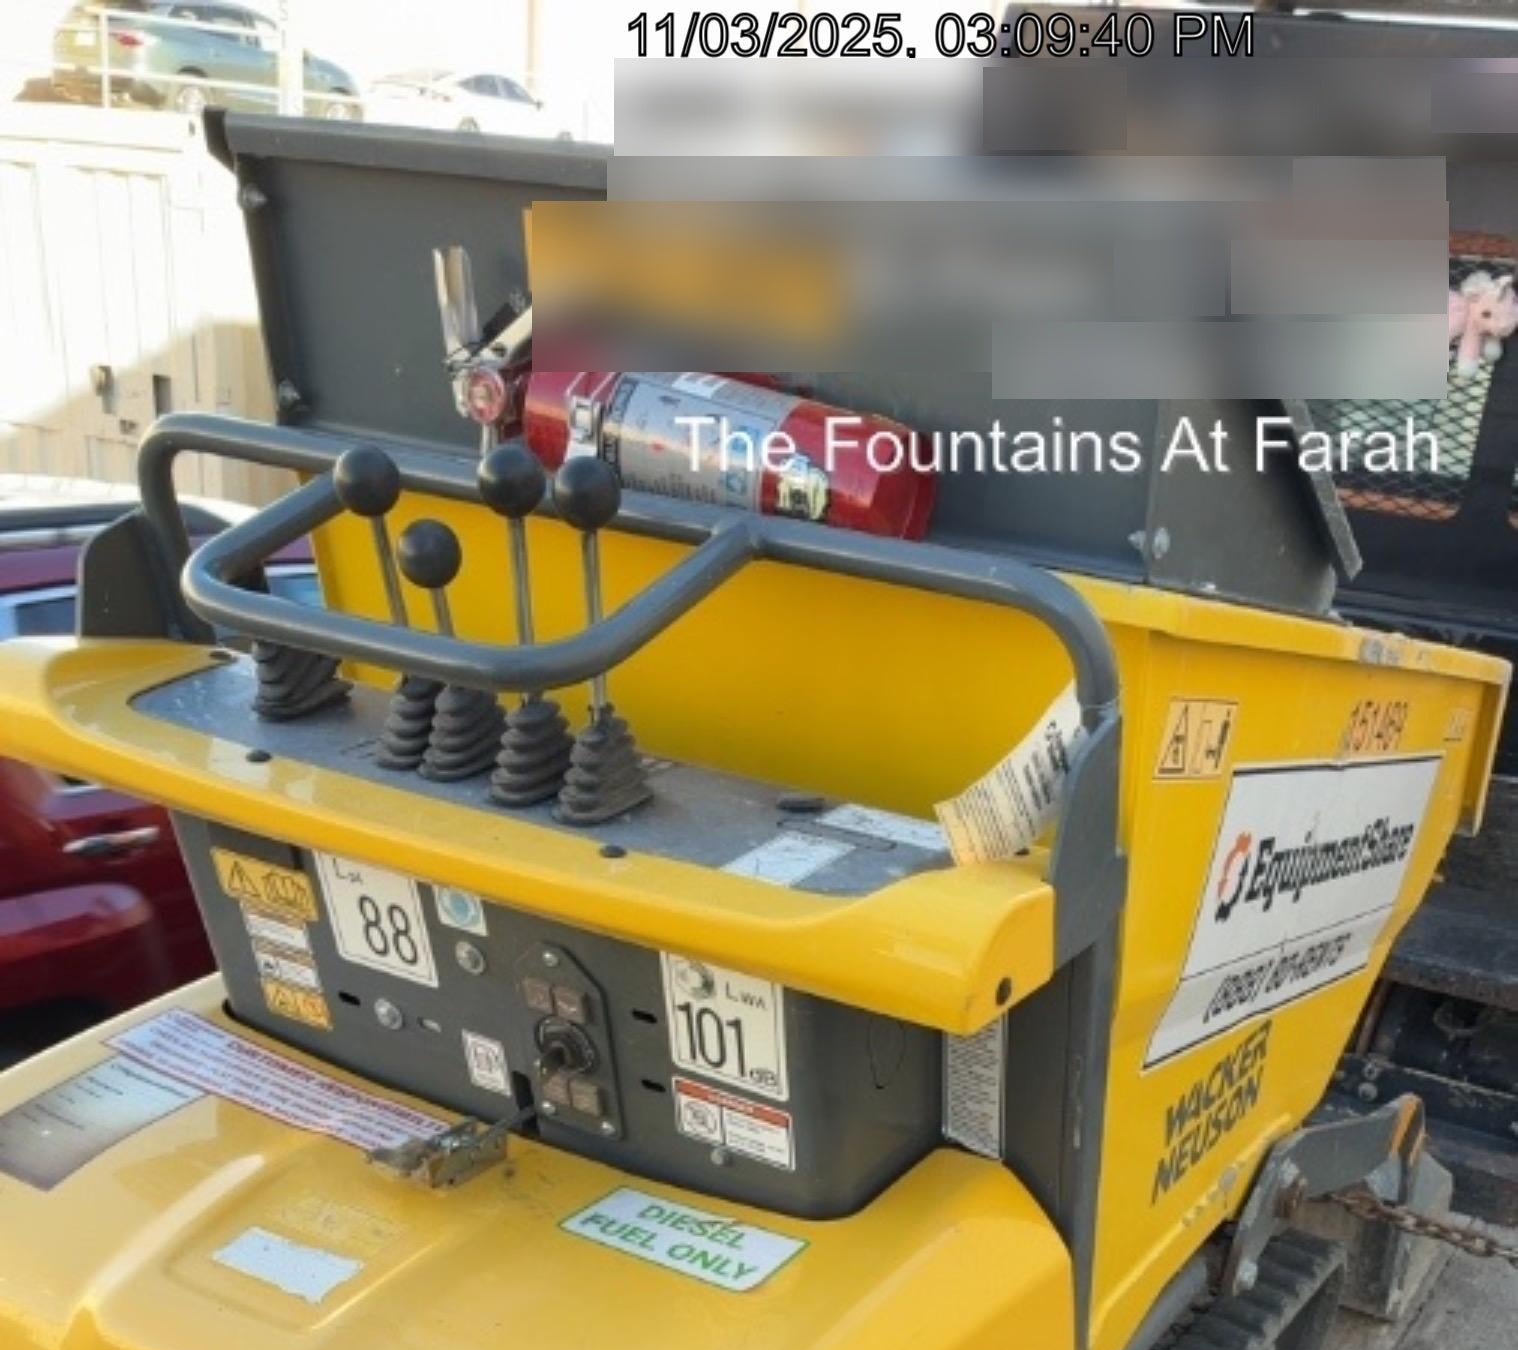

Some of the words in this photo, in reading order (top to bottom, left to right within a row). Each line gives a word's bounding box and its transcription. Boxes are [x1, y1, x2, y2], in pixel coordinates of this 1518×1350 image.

[1244, 817, 1415, 913] EquipmentShare
[358, 893, 419, 966] 88
[674, 1000, 747, 1078] 101
[1165, 1018, 1273, 1146] WACKER
[1151, 1063, 1264, 1206] NEUSON
[579, 1211, 657, 1252] FUEL
[667, 1242, 760, 1283] ONLY
[636, 1203, 750, 1251] DIESEL
